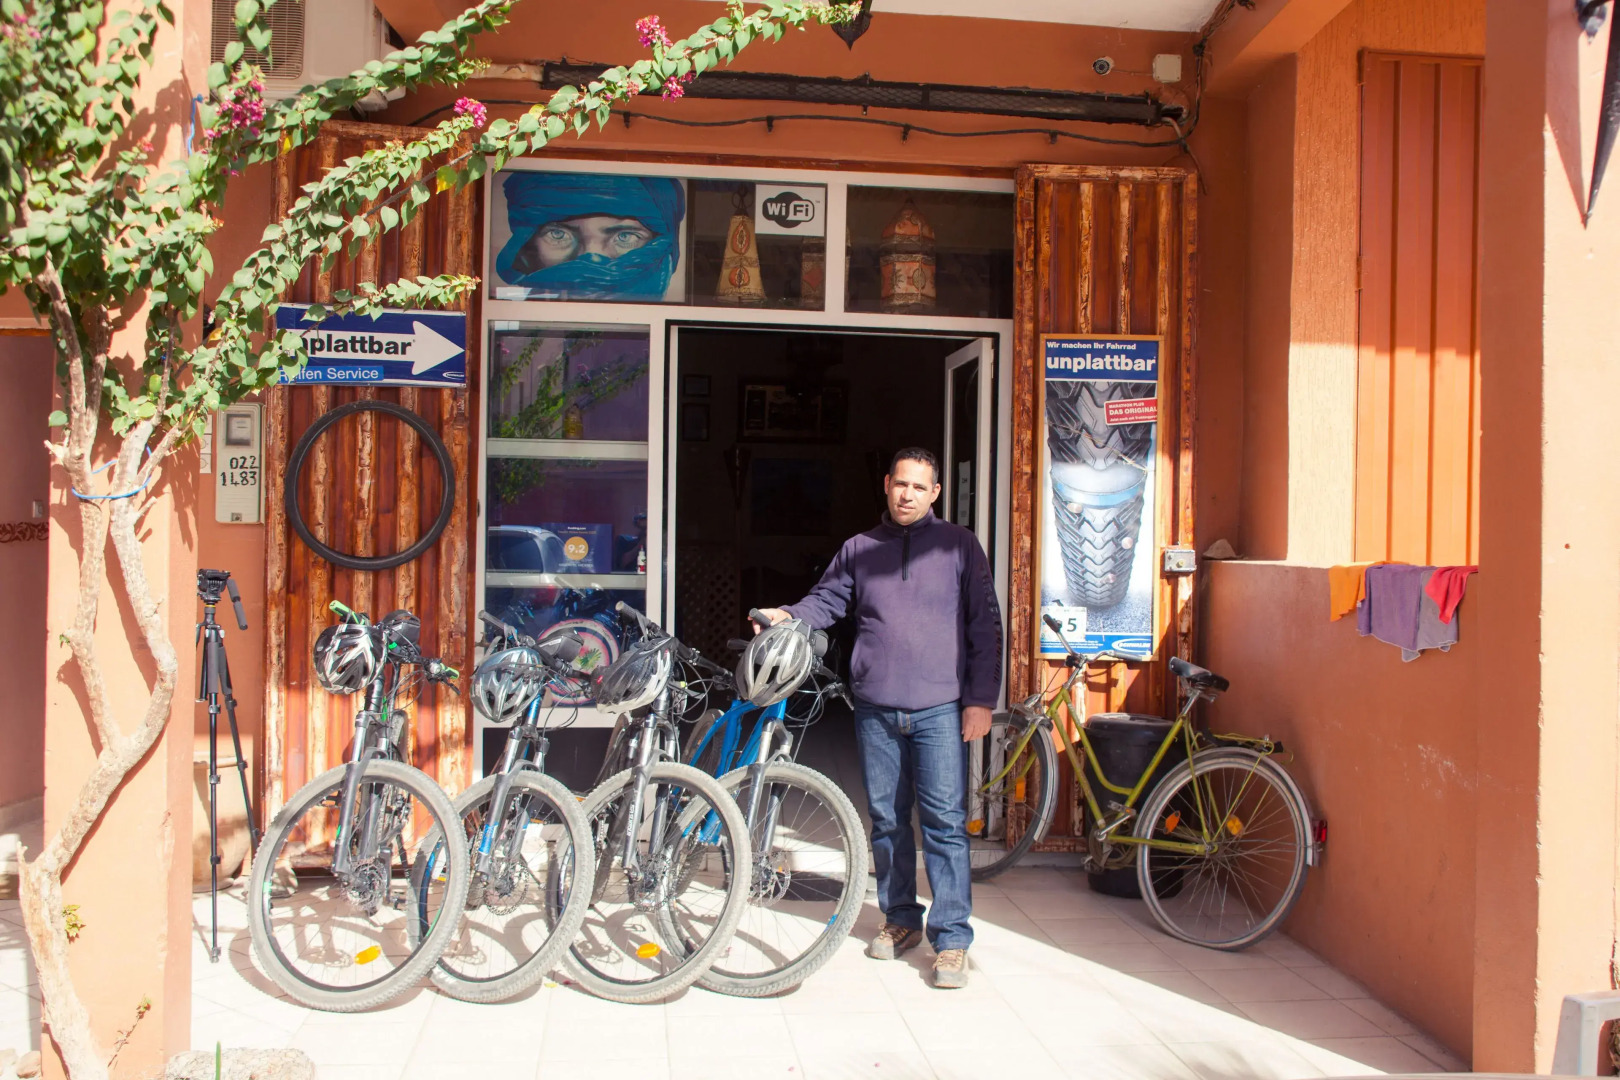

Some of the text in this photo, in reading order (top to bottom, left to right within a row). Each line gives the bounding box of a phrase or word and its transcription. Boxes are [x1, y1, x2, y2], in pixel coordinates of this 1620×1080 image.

[767, 202, 809, 217] WiFi
[1046, 341, 1060, 349] Wir
[1106, 342, 1136, 350] Fahrrad
[1047, 353, 1155, 373] unplattbar
[279, 367, 379, 381] Rifen Service
[230, 456, 260, 469] 022
[568, 544, 586, 554] 9.2
